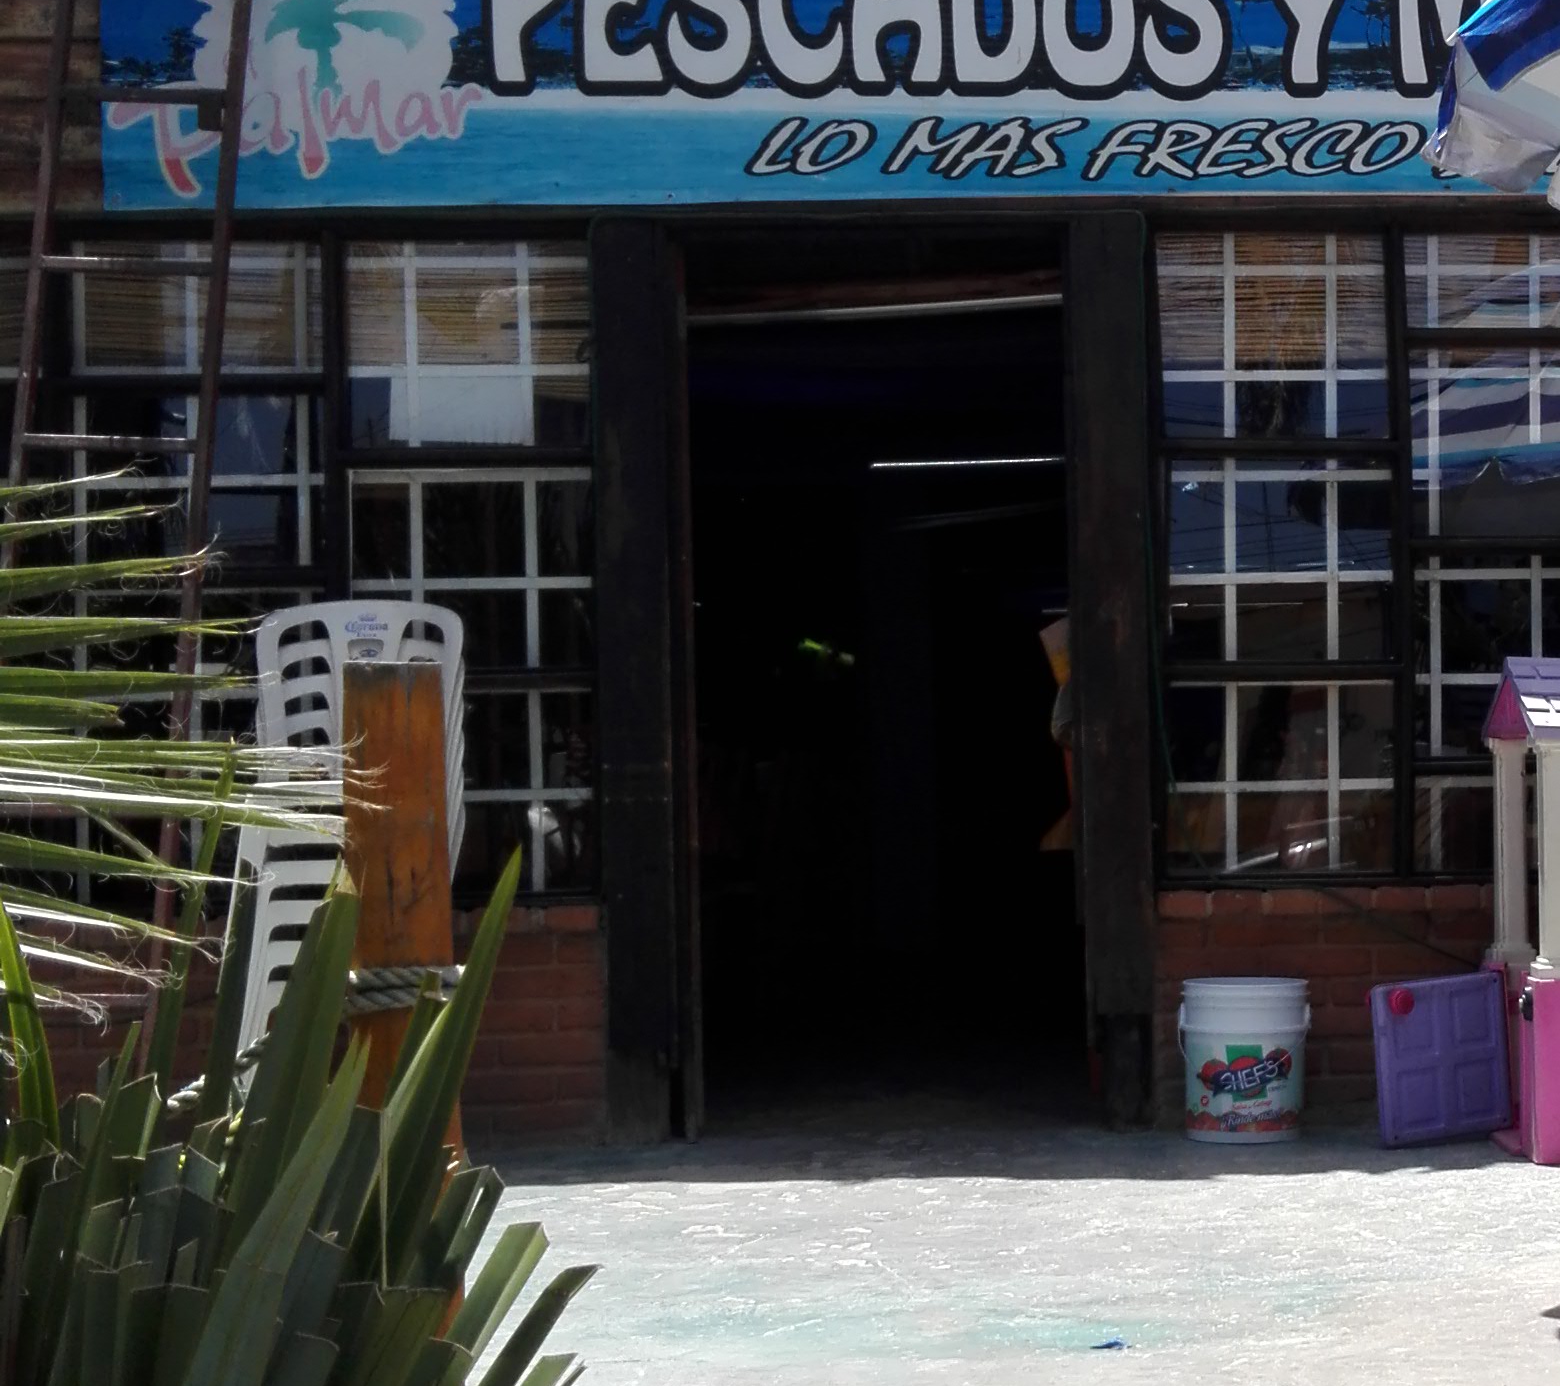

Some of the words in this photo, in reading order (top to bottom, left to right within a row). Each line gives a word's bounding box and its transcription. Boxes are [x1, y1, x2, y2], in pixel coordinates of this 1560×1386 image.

[746, 116, 878, 176] LO
[882, 116, 1091, 179] MAS
[1083, 119, 1428, 182] FRESCO
